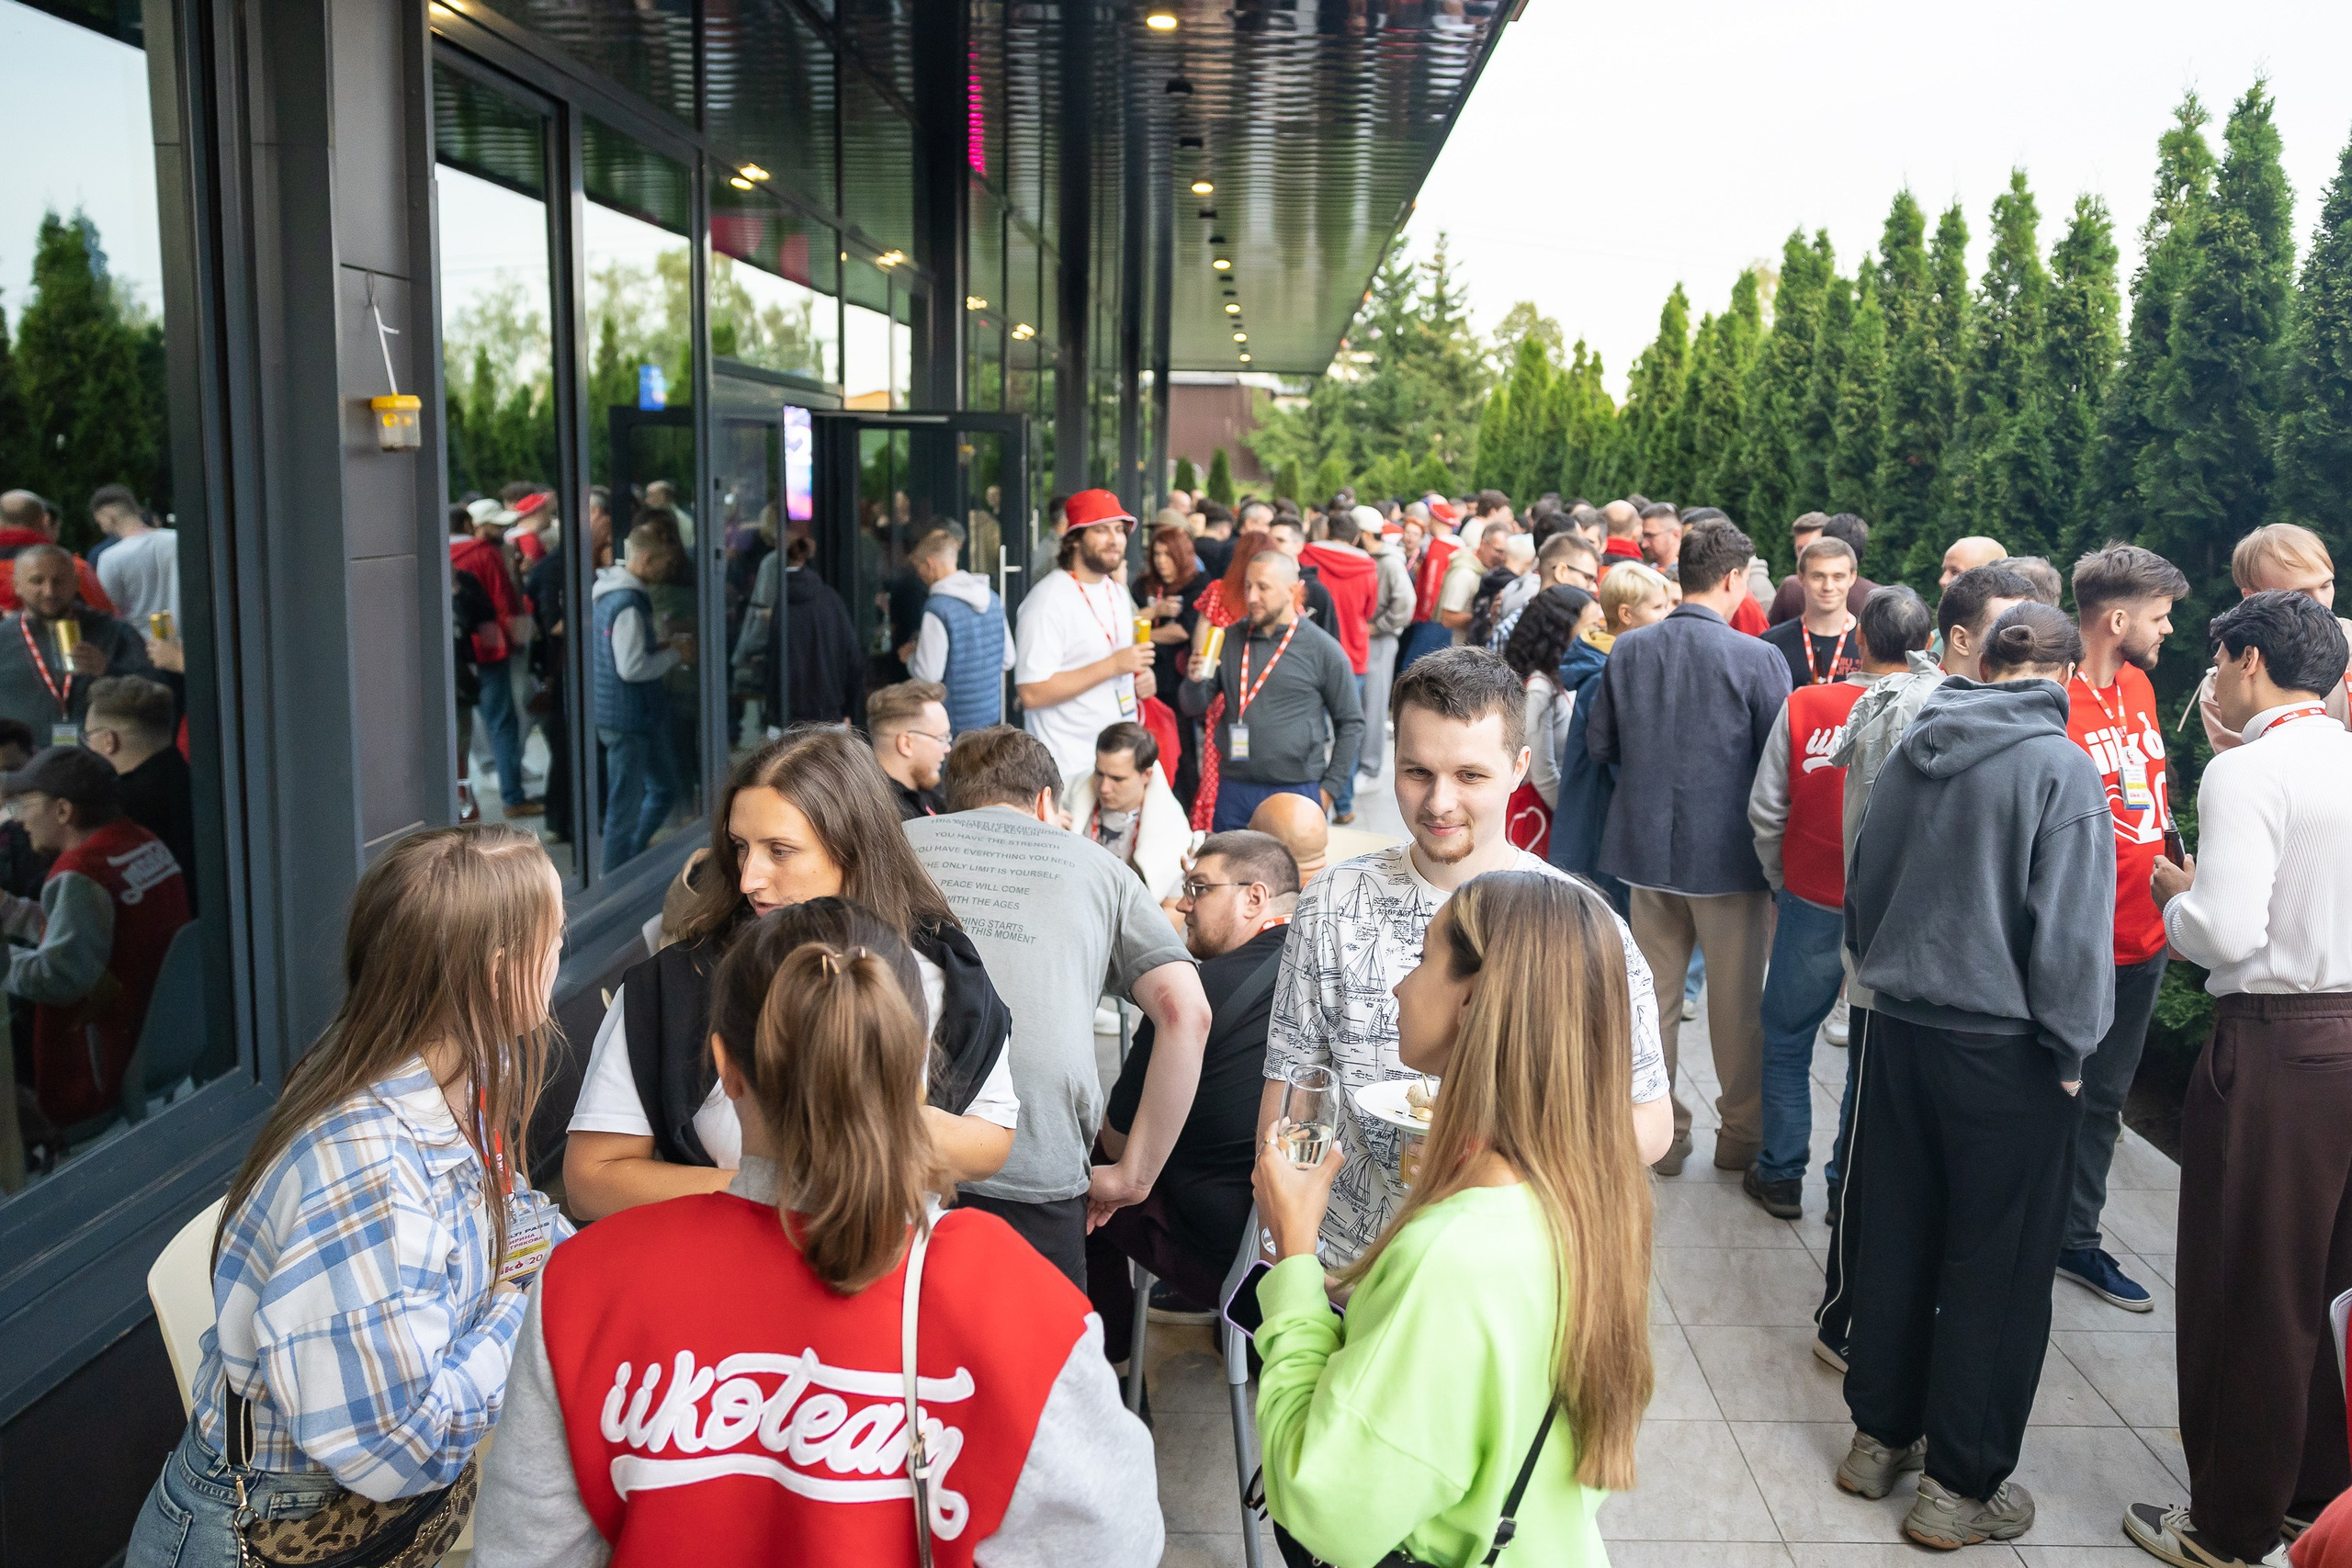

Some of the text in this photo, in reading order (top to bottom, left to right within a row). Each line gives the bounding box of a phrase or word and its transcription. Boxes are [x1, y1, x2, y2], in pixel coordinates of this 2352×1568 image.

[957, 833, 985, 842] HAVE
[987, 837, 1006, 845] THE
[1008, 840, 1060, 851] STRENGTH
[963, 848, 1026, 861] EVERYTHING
[1051, 857, 1076, 868] NEED
[942, 862, 967, 870] ONLY
[969, 864, 995, 874] LIMIT
[1010, 869, 1061, 881] YOURSELF
[940, 879, 1031, 896] PEACE WILL COME
[972, 897, 991, 907] THE
[993, 900, 1020, 910] AGES
[988, 919, 1024, 932] STARTS
[971, 926, 992, 937] THIS
[994, 930, 1036, 944] MOMENT
[525, 1222, 550, 1233] PASS
[529, 1254, 543, 1265] 20
